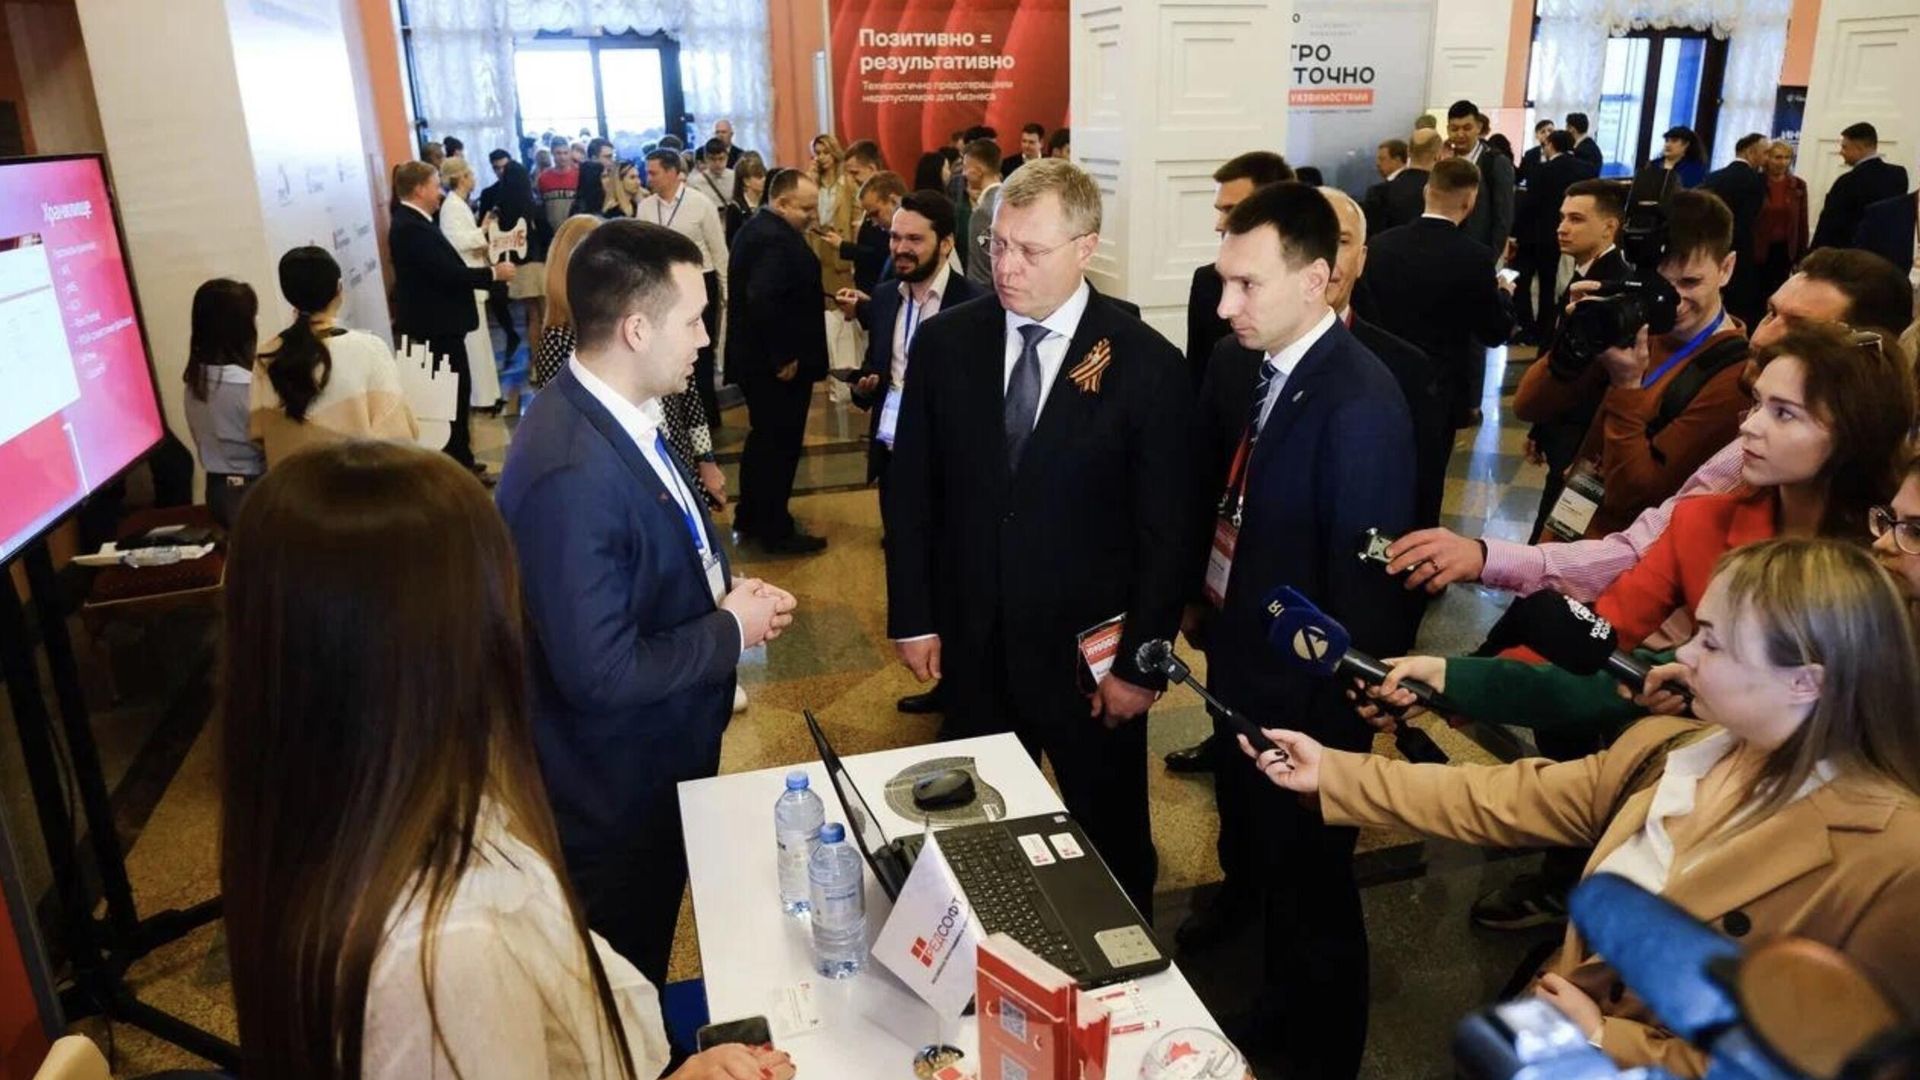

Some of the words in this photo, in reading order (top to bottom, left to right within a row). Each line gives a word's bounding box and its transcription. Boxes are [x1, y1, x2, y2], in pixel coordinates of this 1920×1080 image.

[858, 28, 975, 47] Позитивно
[980, 33, 993, 44] =
[860, 54, 1015, 75] результативно
[1293, 66, 1375, 84] ТОЧНО
[862, 80, 931, 91] Технологично
[862, 92, 934, 105] недопустимое
[937, 93, 953, 103] для
[956, 91, 997, 102] бизнеса
[925, 895, 964, 958] РЕДСОФТ
